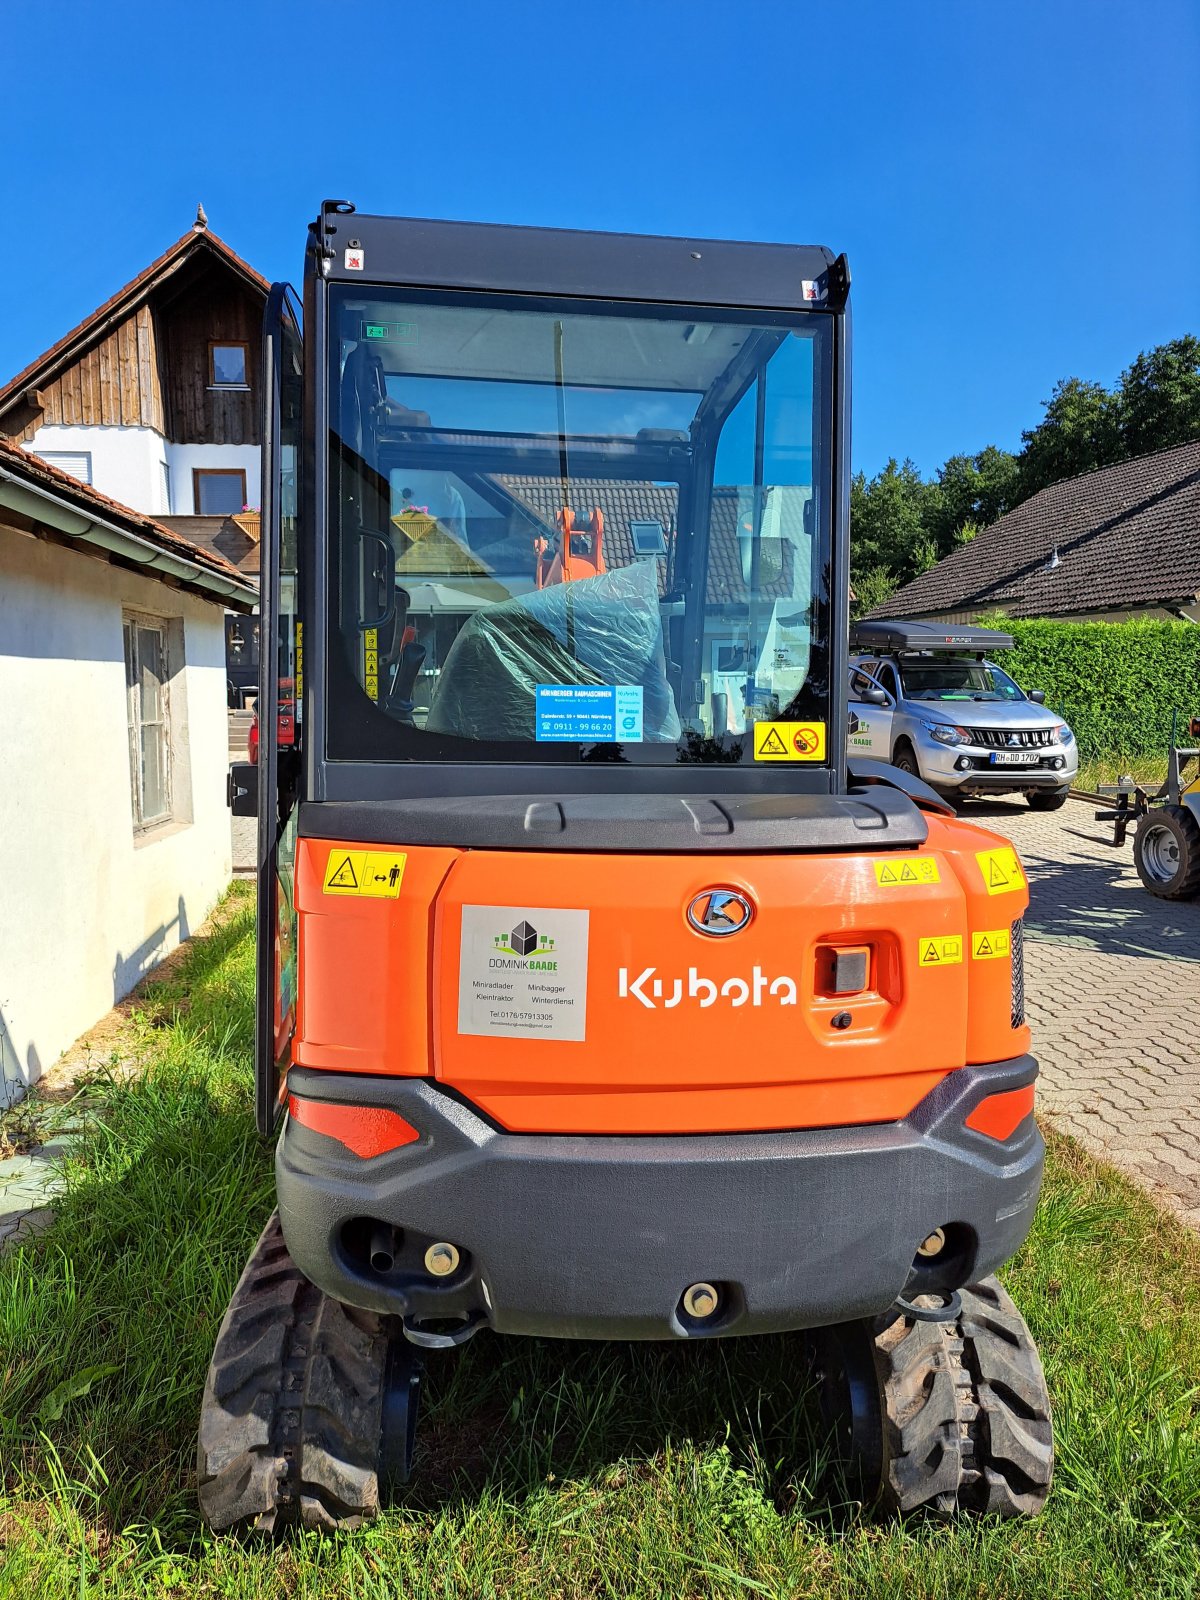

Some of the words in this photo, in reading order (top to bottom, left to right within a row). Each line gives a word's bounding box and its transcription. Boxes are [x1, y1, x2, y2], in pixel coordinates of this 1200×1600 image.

[540, 689, 573, 697] NÜRNBERGER
[553, 723, 573, 731] 0911
[579, 723, 589, 731] 99
[591, 723, 601, 731] 66
[602, 723, 612, 731] 20
[853, 738, 873, 746] BAADE
[1021, 754, 1039, 762] 1707
[472, 980, 514, 990] Miniradlader
[527, 984, 566, 993] Minibagger
[618, 965, 797, 1009] Kubota
[476, 993, 514, 1002] Kleintraktor
[531, 996, 574, 1005] Winterdienst
